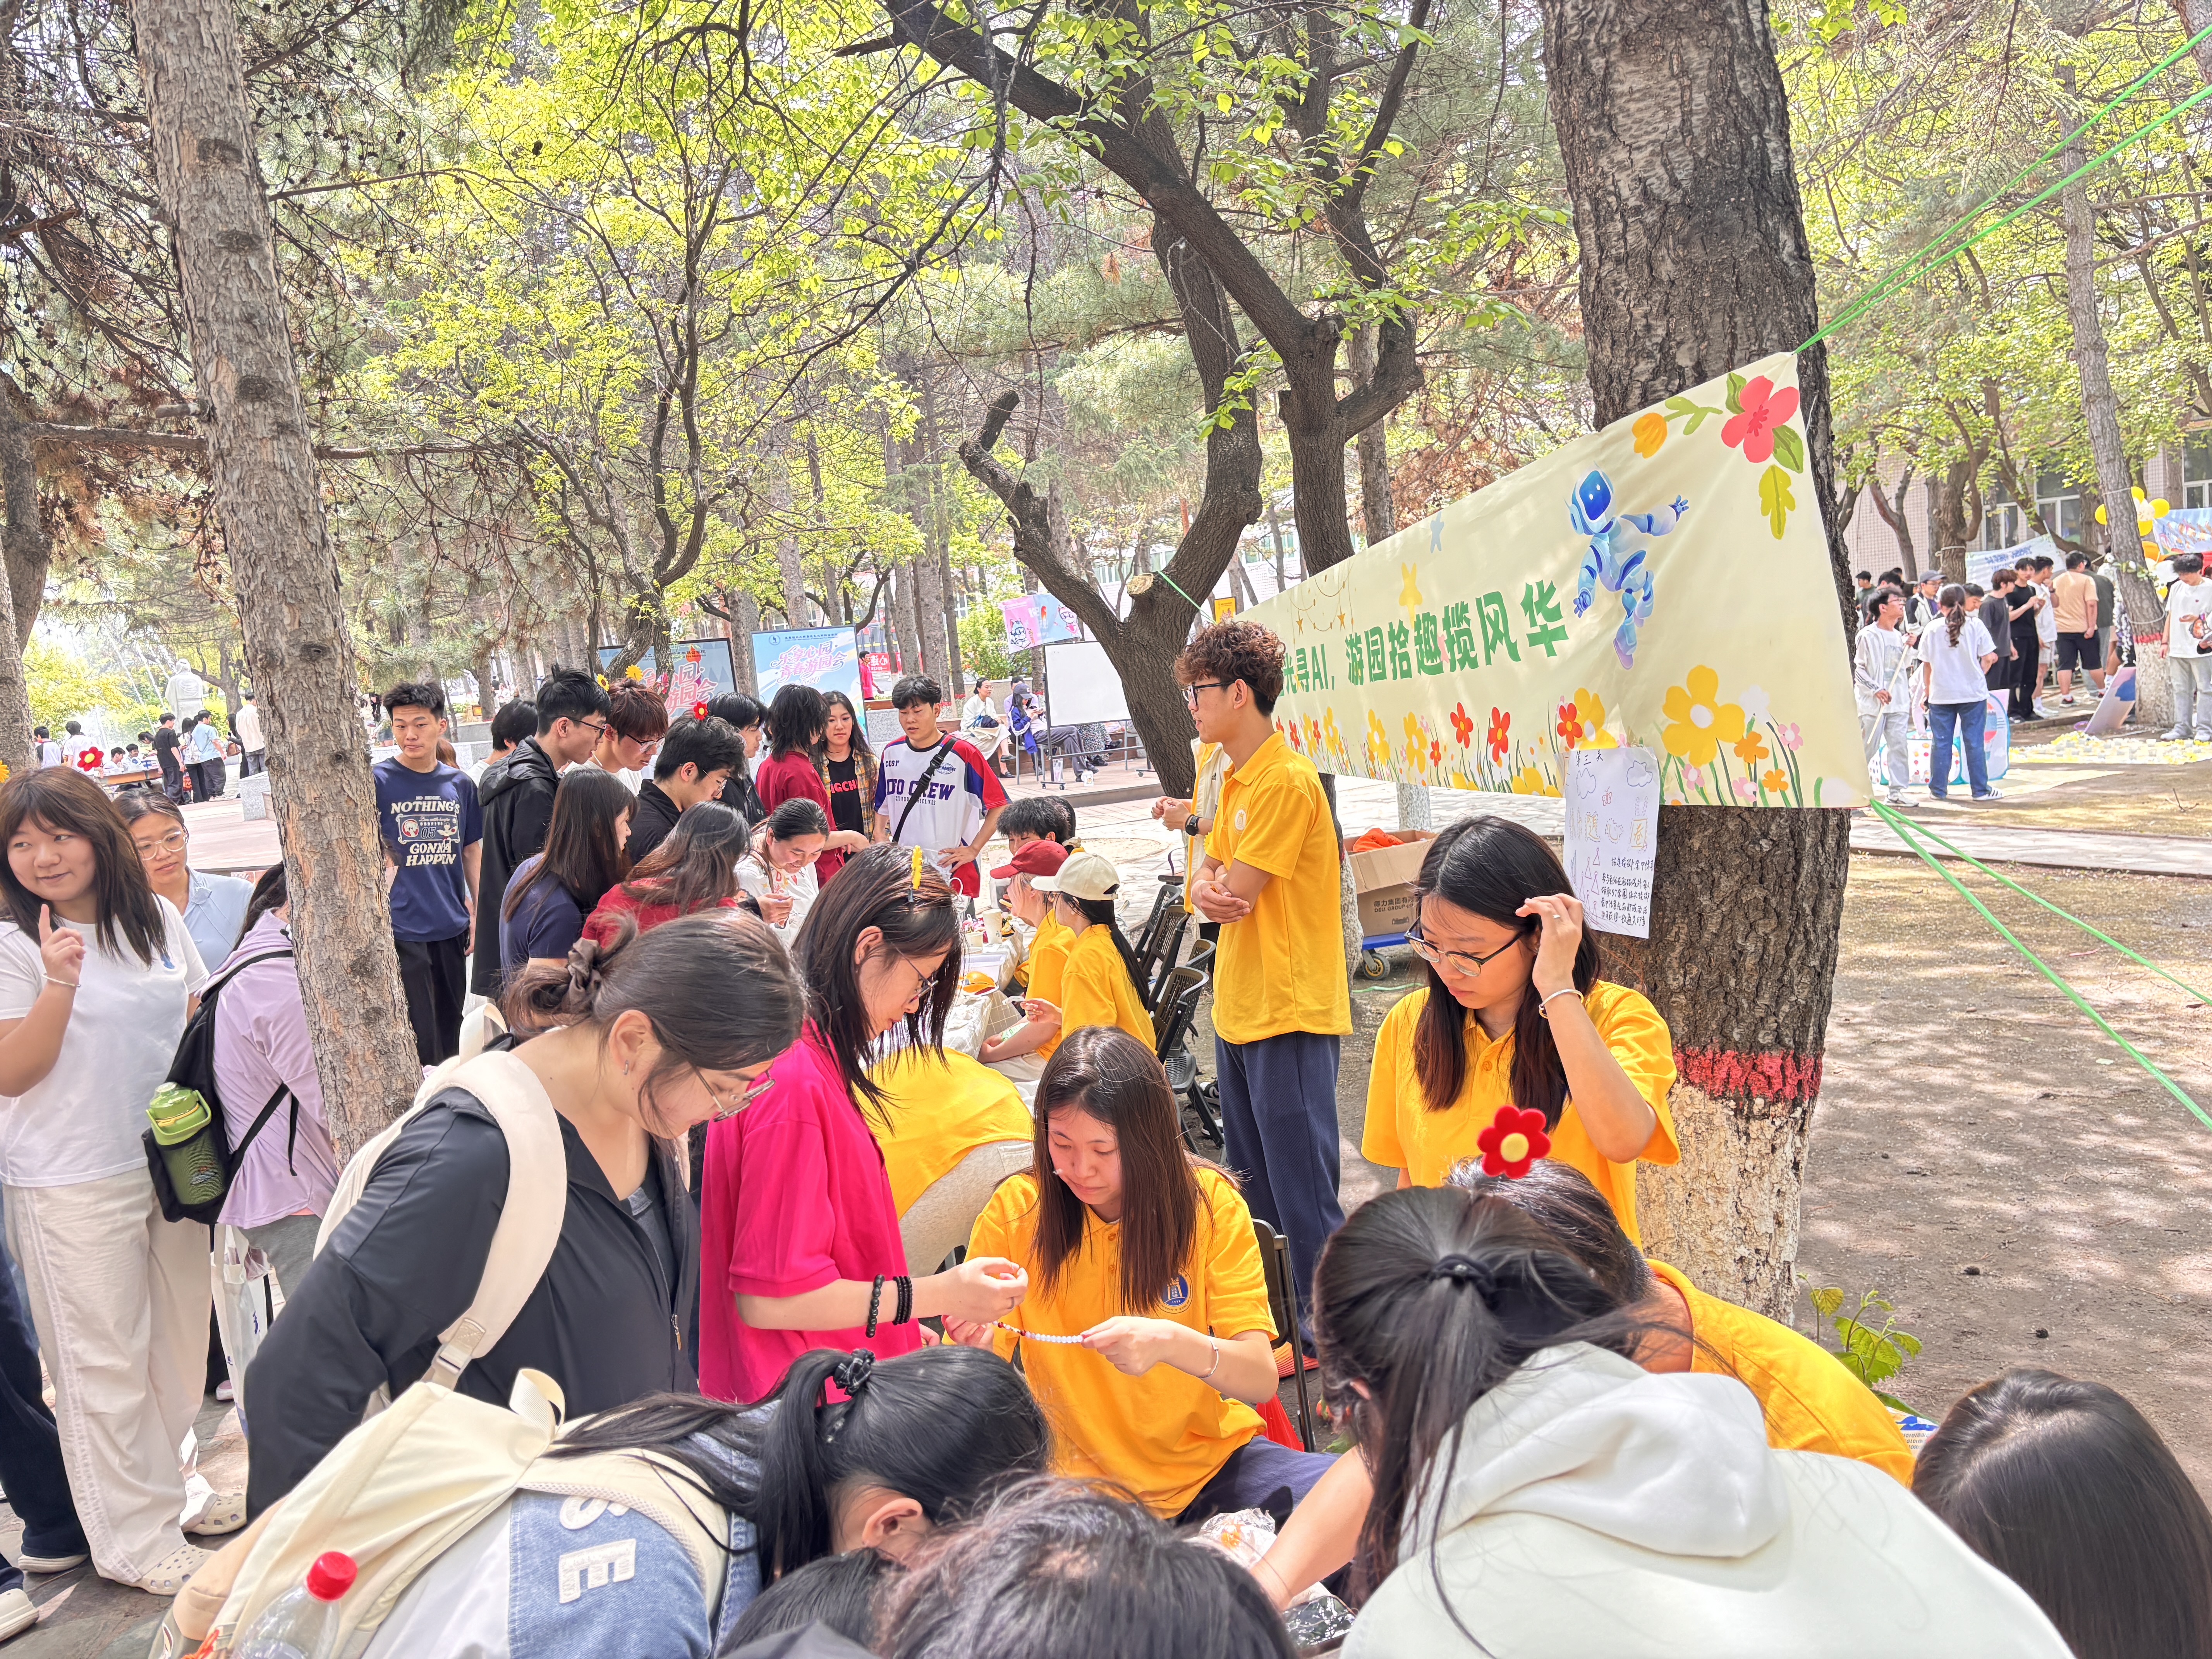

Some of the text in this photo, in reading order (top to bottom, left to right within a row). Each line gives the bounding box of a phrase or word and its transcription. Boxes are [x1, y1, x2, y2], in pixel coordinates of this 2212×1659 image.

[1279, 580, 1569, 697] 光寻AI，游园拾趣揽风华
[771, 641, 832, 667] 乐享心园
[777, 652, 847, 683] 青春游园会
[887, 779, 955, 801] DO CEW
[391, 800, 460, 814] NOTHING'S
[421, 827, 436, 839] 05
[409, 843, 452, 854] GONNA
[405, 854, 457, 866] HAPPEN
